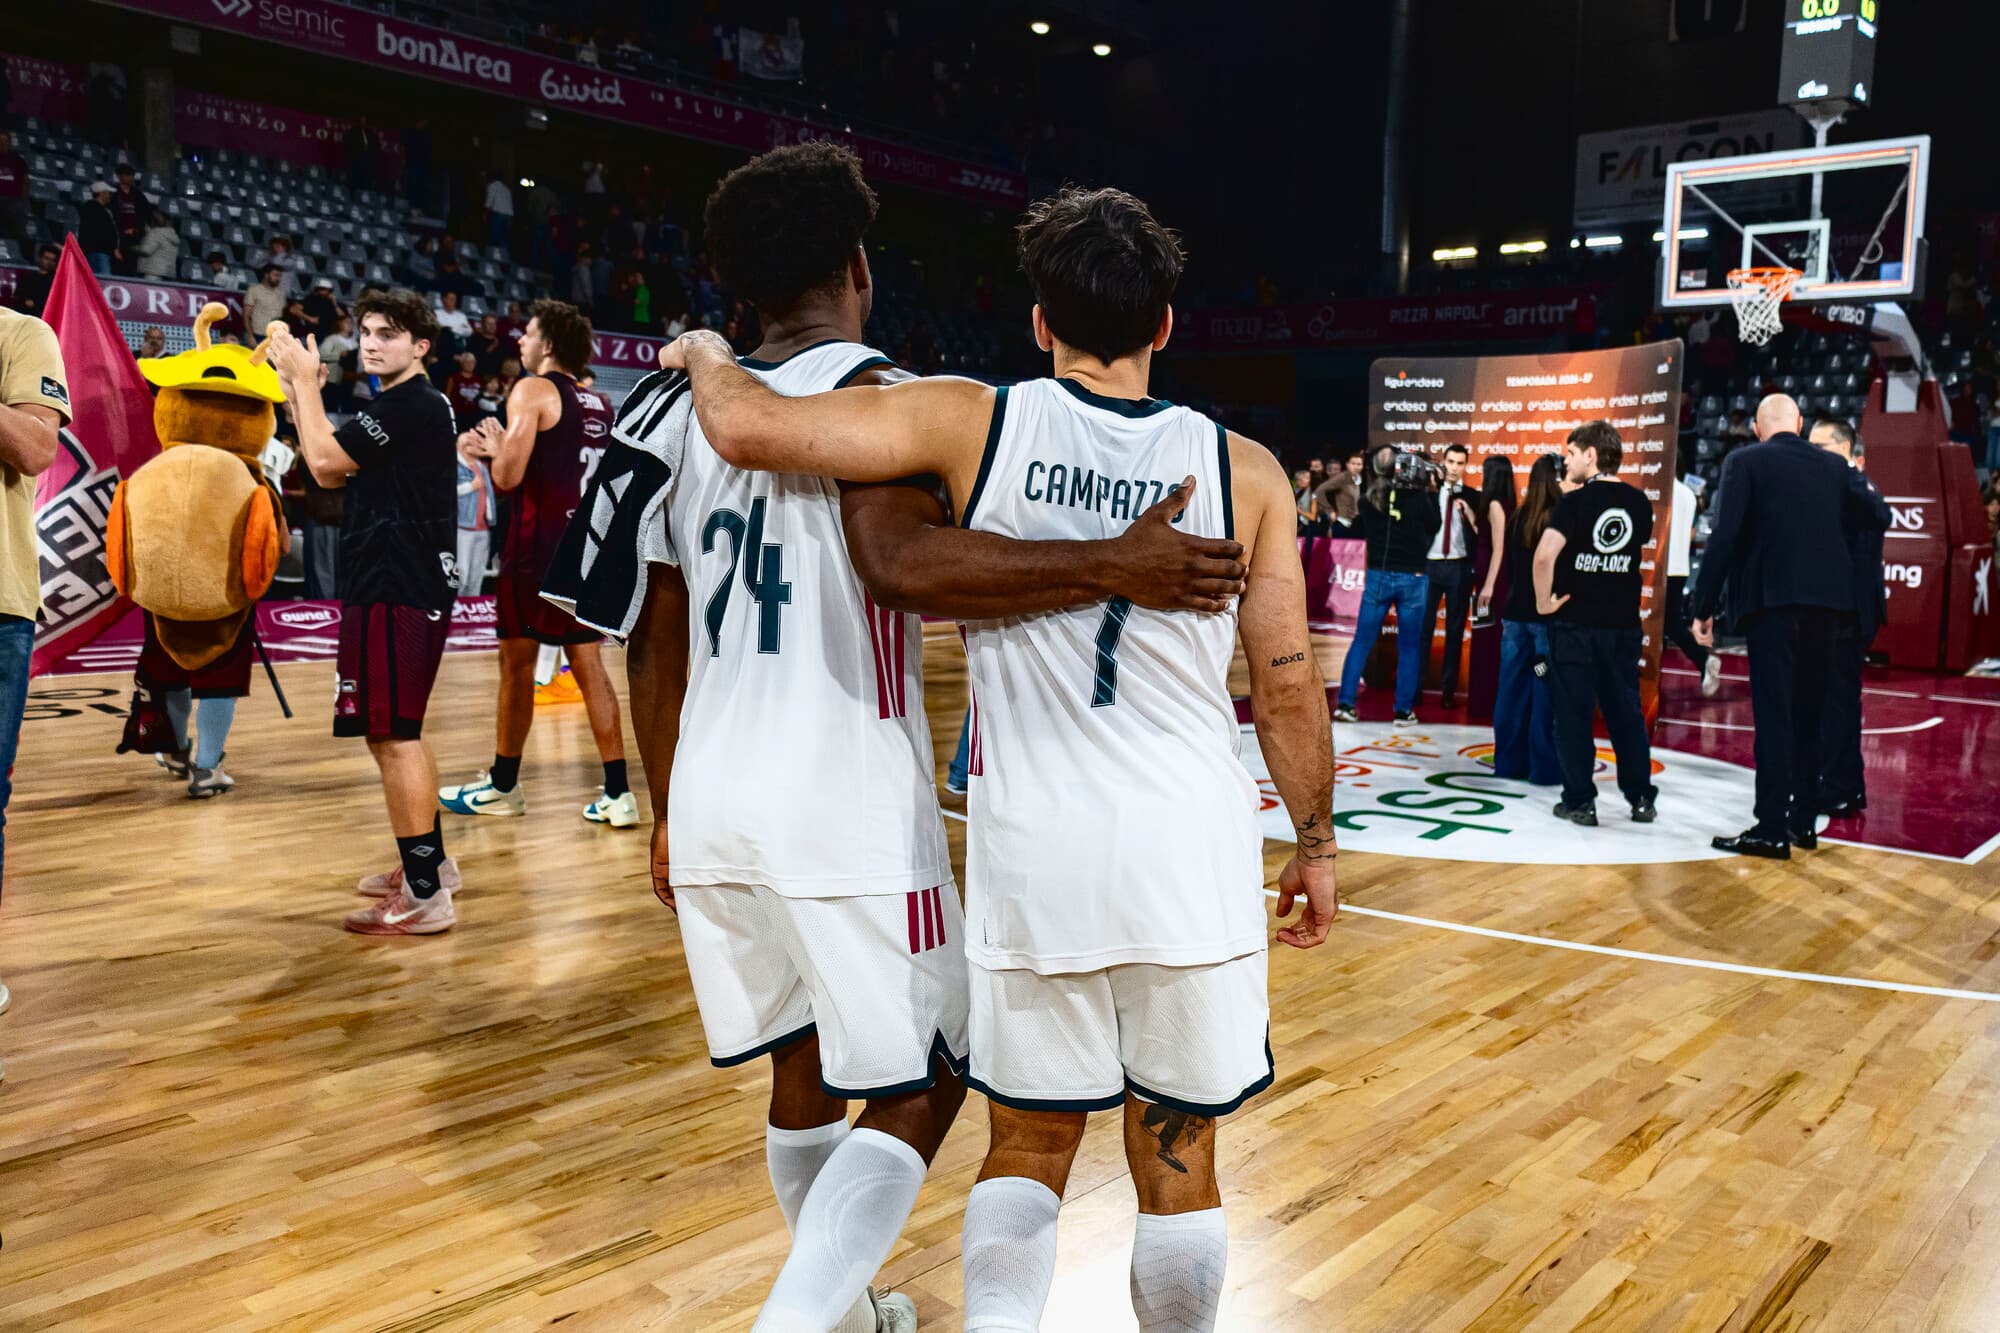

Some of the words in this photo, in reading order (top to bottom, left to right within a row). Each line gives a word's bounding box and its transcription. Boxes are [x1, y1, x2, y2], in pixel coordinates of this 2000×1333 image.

[258, 0, 345, 39] semic
[1384, 400, 1427, 413] endesa
[1433, 400, 1475, 413] endesa
[1481, 400, 1522, 413] endesa
[1527, 398, 1566, 412] endesa
[579, 446, 609, 499] 2
[701, 496, 792, 657] 24
